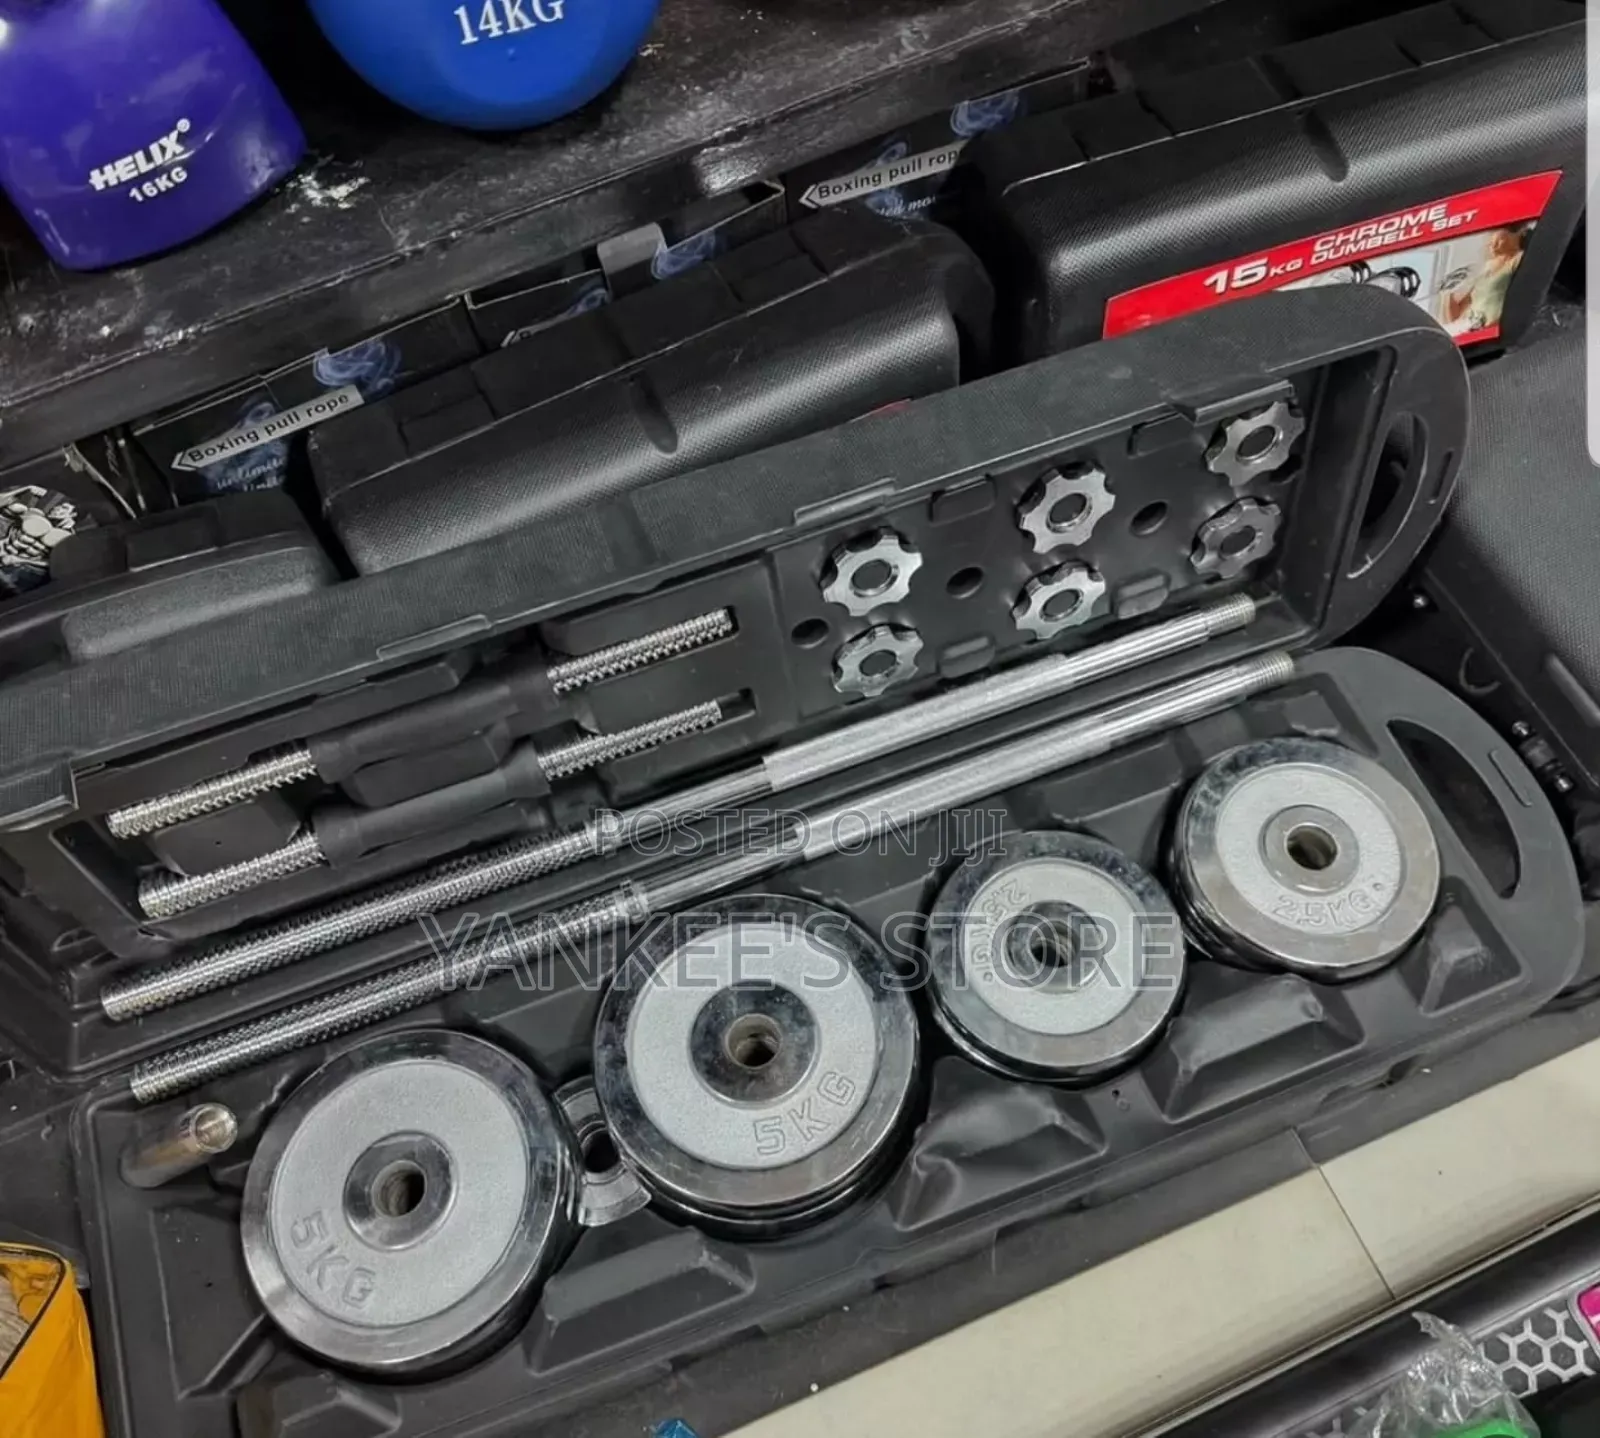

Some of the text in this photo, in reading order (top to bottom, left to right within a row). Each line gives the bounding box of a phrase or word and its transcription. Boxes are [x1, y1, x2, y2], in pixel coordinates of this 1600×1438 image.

[453, 0, 565, 45] 14KG
[129, 166, 188, 202] 16KG
[818, 149, 958, 199] Boxing pull rop
[1310, 209, 1479, 265] DUMBELL SET
[1314, 203, 1448, 253] CHROME
[187, 392, 350, 463] Boxing pull rope
[753, 1071, 857, 1156] 5KG
[290, 1208, 377, 1311] 5KG
